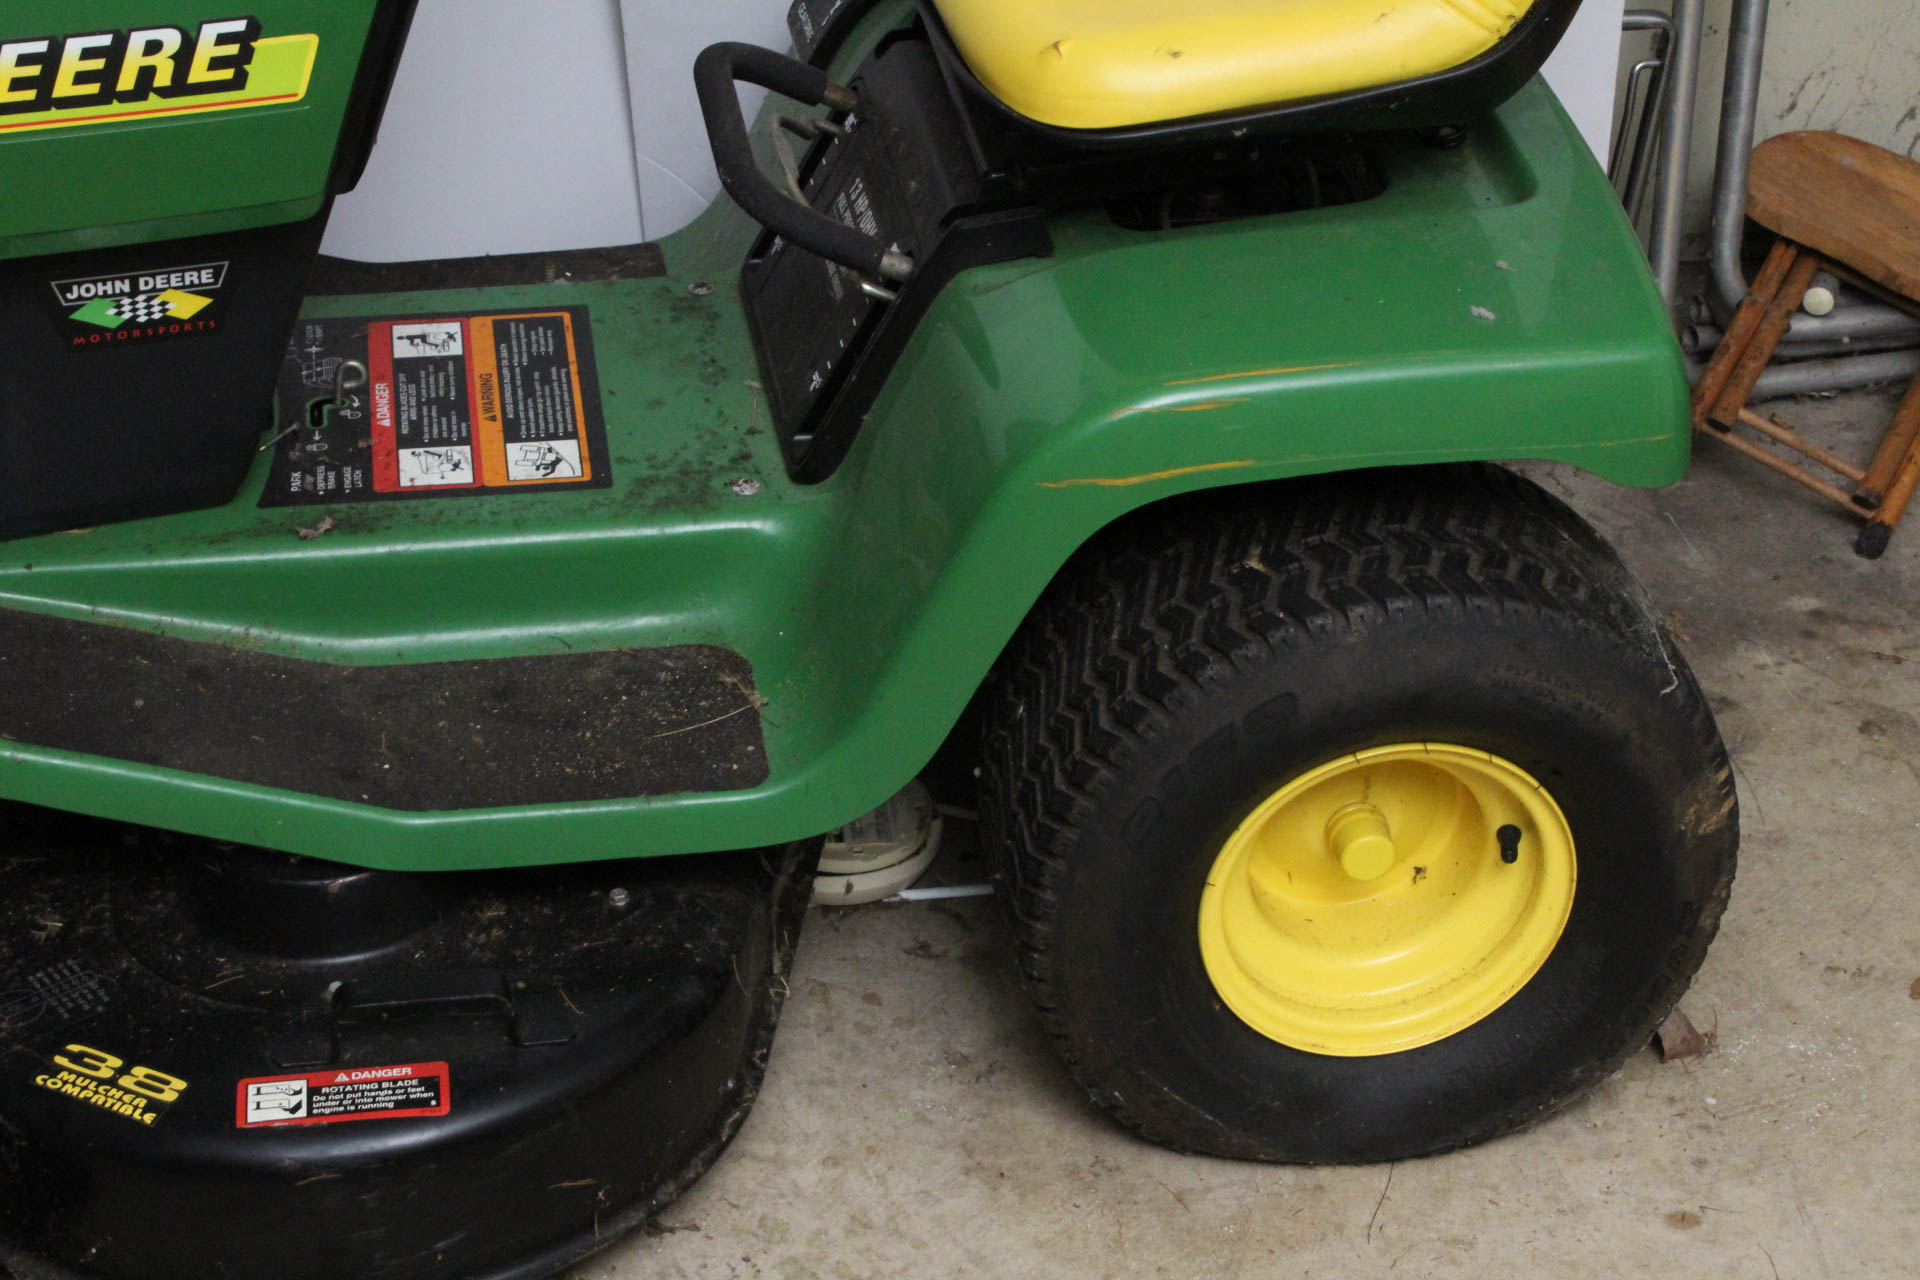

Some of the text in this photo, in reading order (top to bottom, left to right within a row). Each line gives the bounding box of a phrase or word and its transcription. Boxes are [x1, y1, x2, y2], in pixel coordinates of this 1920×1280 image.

[849, 177, 863, 201] 13
[66, 269, 214, 300] JOHN DEERE
[73, 320, 216, 345] MOTORSPORTS
[375, 383, 391, 420] DANGER
[479, 373, 494, 414] WARNING
[290, 471, 302, 492] PARK
[317, 465, 326, 490] DEPRESS
[327, 470, 336, 490] BRAKE
[343, 465, 352, 489] ENGAGE
[353, 470, 363, 488] LATCH
[53, 1043, 188, 1103] 38
[351, 1067, 413, 1081] DANGER
[56, 1071, 148, 1108] MULCHER
[312, 1094, 327, 1102] Do
[329, 1092, 345, 1101] not
[346, 1091, 362, 1101] put
[364, 1088, 393, 1098] hands
[407, 1085, 426, 1094] feet
[321, 1078, 419, 1094] ROTATING BLADE
[35, 1074, 157, 1124] COMPATIBLE
[312, 1099, 340, 1108] under
[355, 1096, 374, 1105] into
[375, 1094, 407, 1103] mower
[409, 1091, 434, 1100] when
[312, 1101, 395, 1115] engine is running
